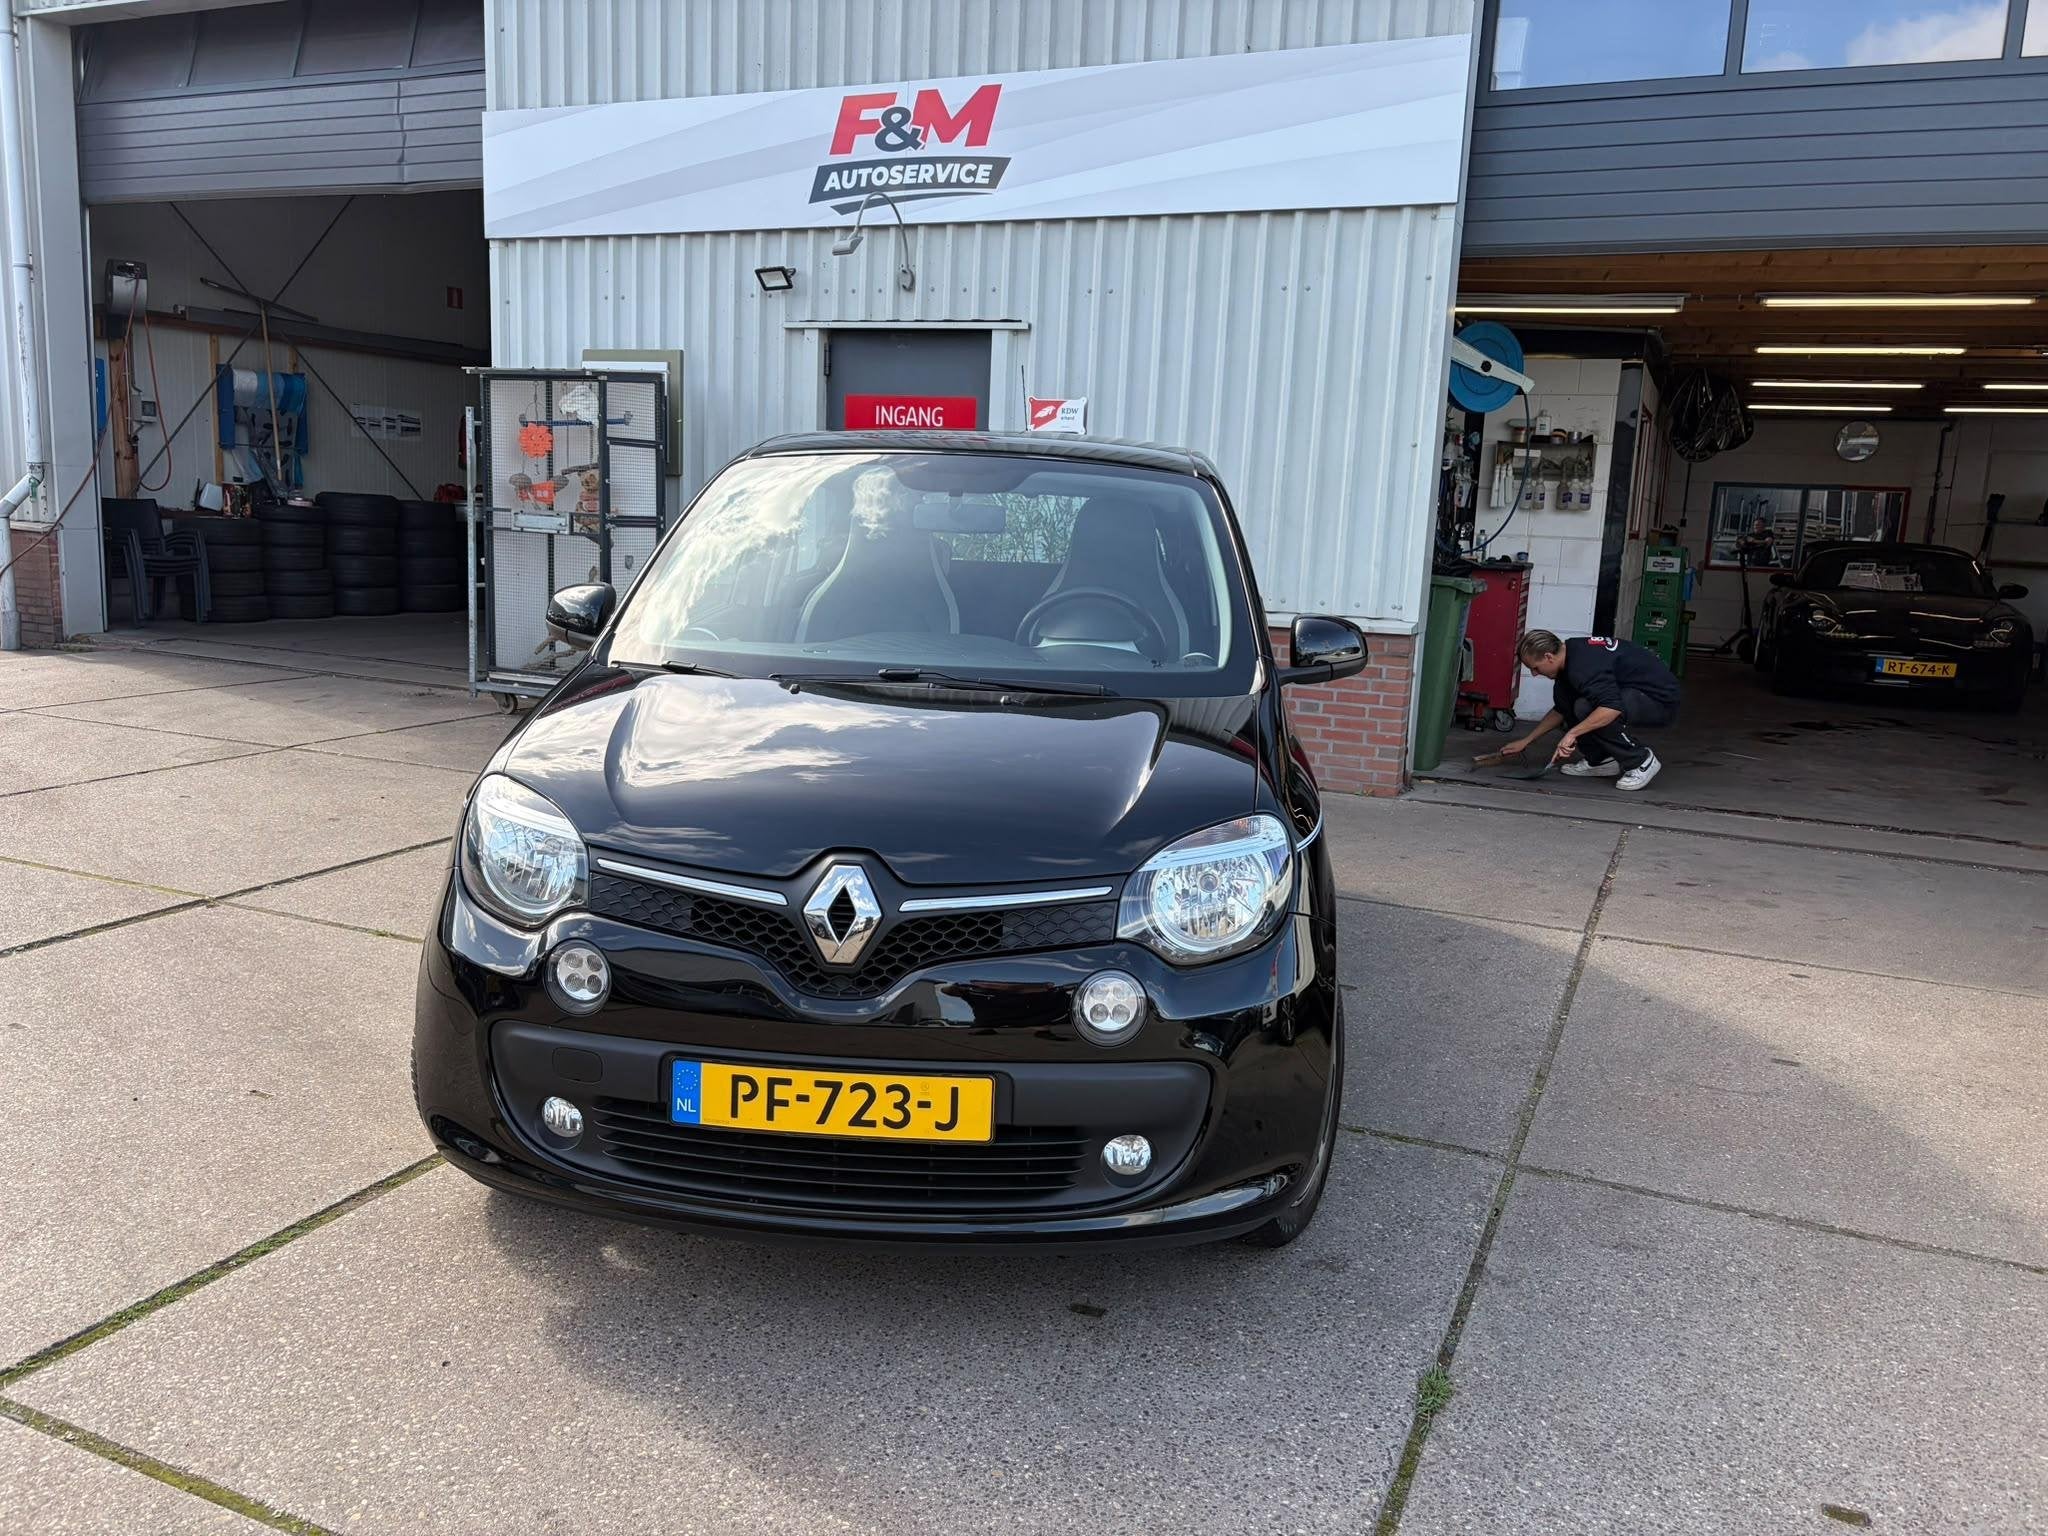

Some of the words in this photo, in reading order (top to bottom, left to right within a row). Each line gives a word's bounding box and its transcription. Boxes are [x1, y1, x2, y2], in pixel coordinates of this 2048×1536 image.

[829, 83, 1003, 156] F&M
[823, 162, 994, 192] AUTOSERVICE
[875, 404, 944, 428] INGANG
[1061, 407, 1079, 415] RDW
[1887, 661, 1950, 676] RT-674-K
[676, 1097, 696, 1113] NL
[730, 1073, 960, 1132] PF-723-J
